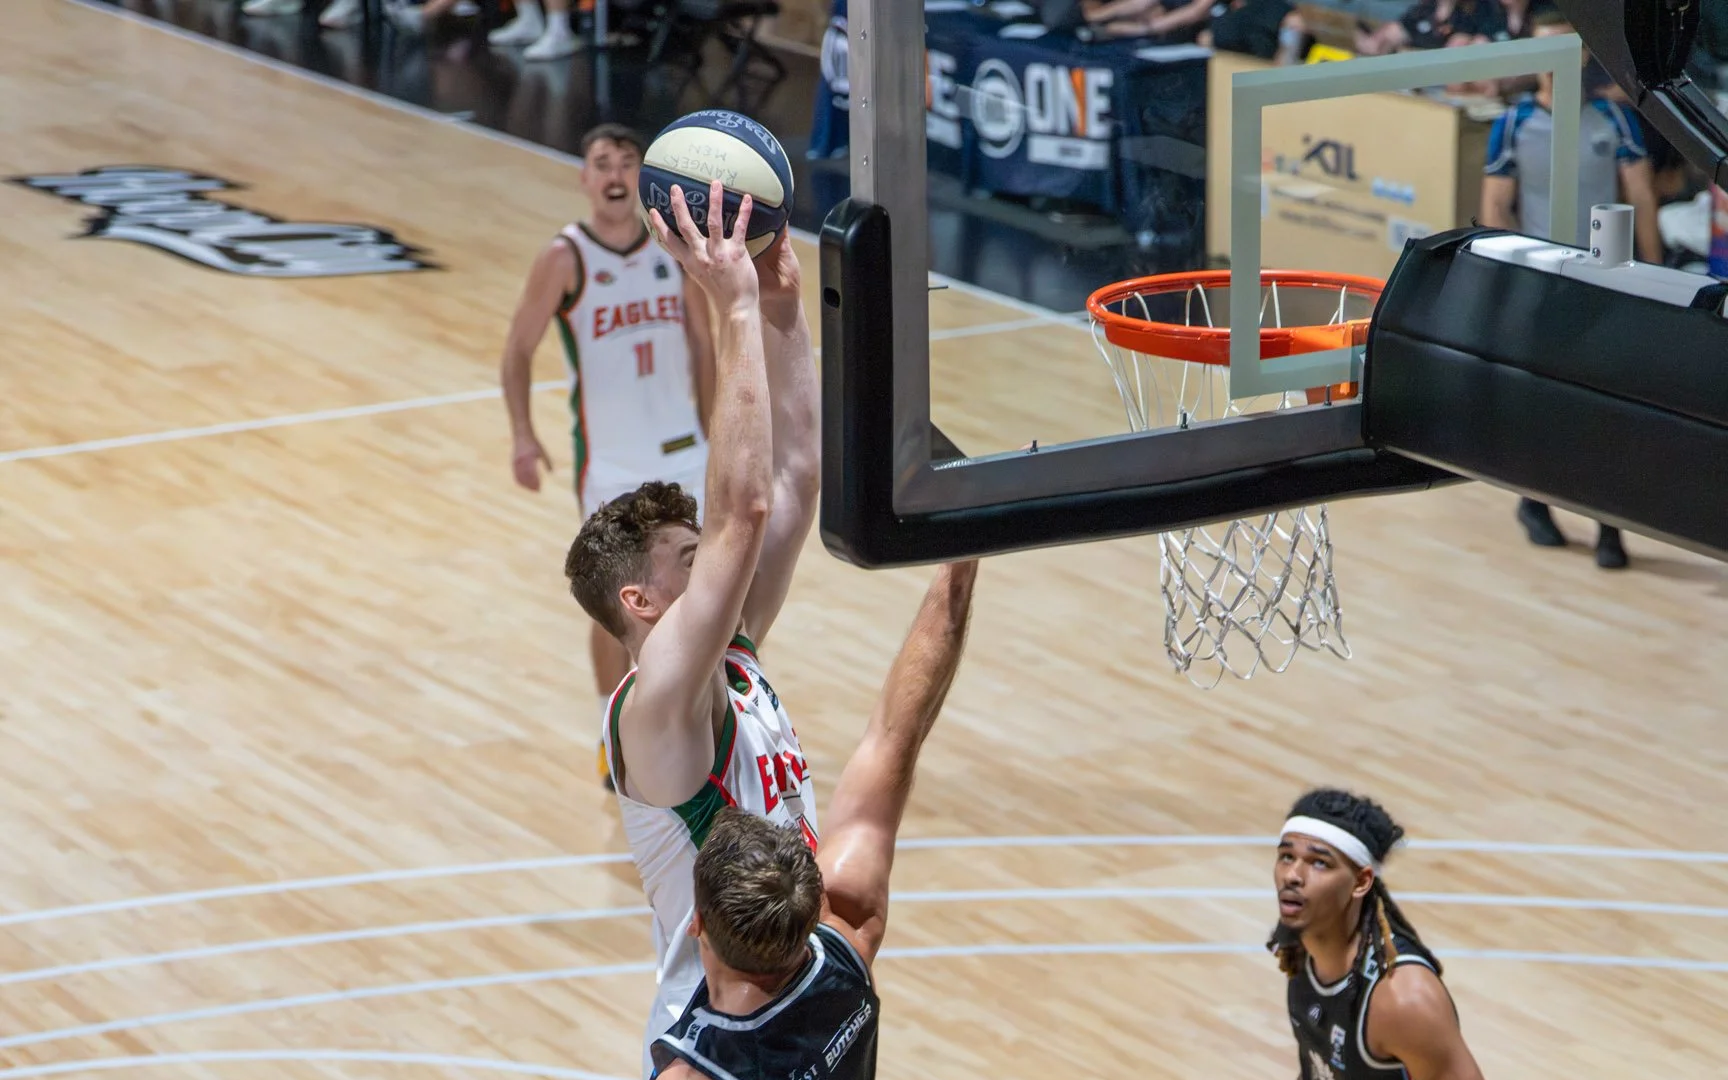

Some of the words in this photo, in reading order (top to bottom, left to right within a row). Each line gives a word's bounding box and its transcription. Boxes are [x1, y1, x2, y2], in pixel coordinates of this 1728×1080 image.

[1024, 62, 1114, 138] ONE
[688, 144, 728, 162] MEN
[634, 340, 654, 377] 11
[825, 1003, 873, 1068] BUTCHER
